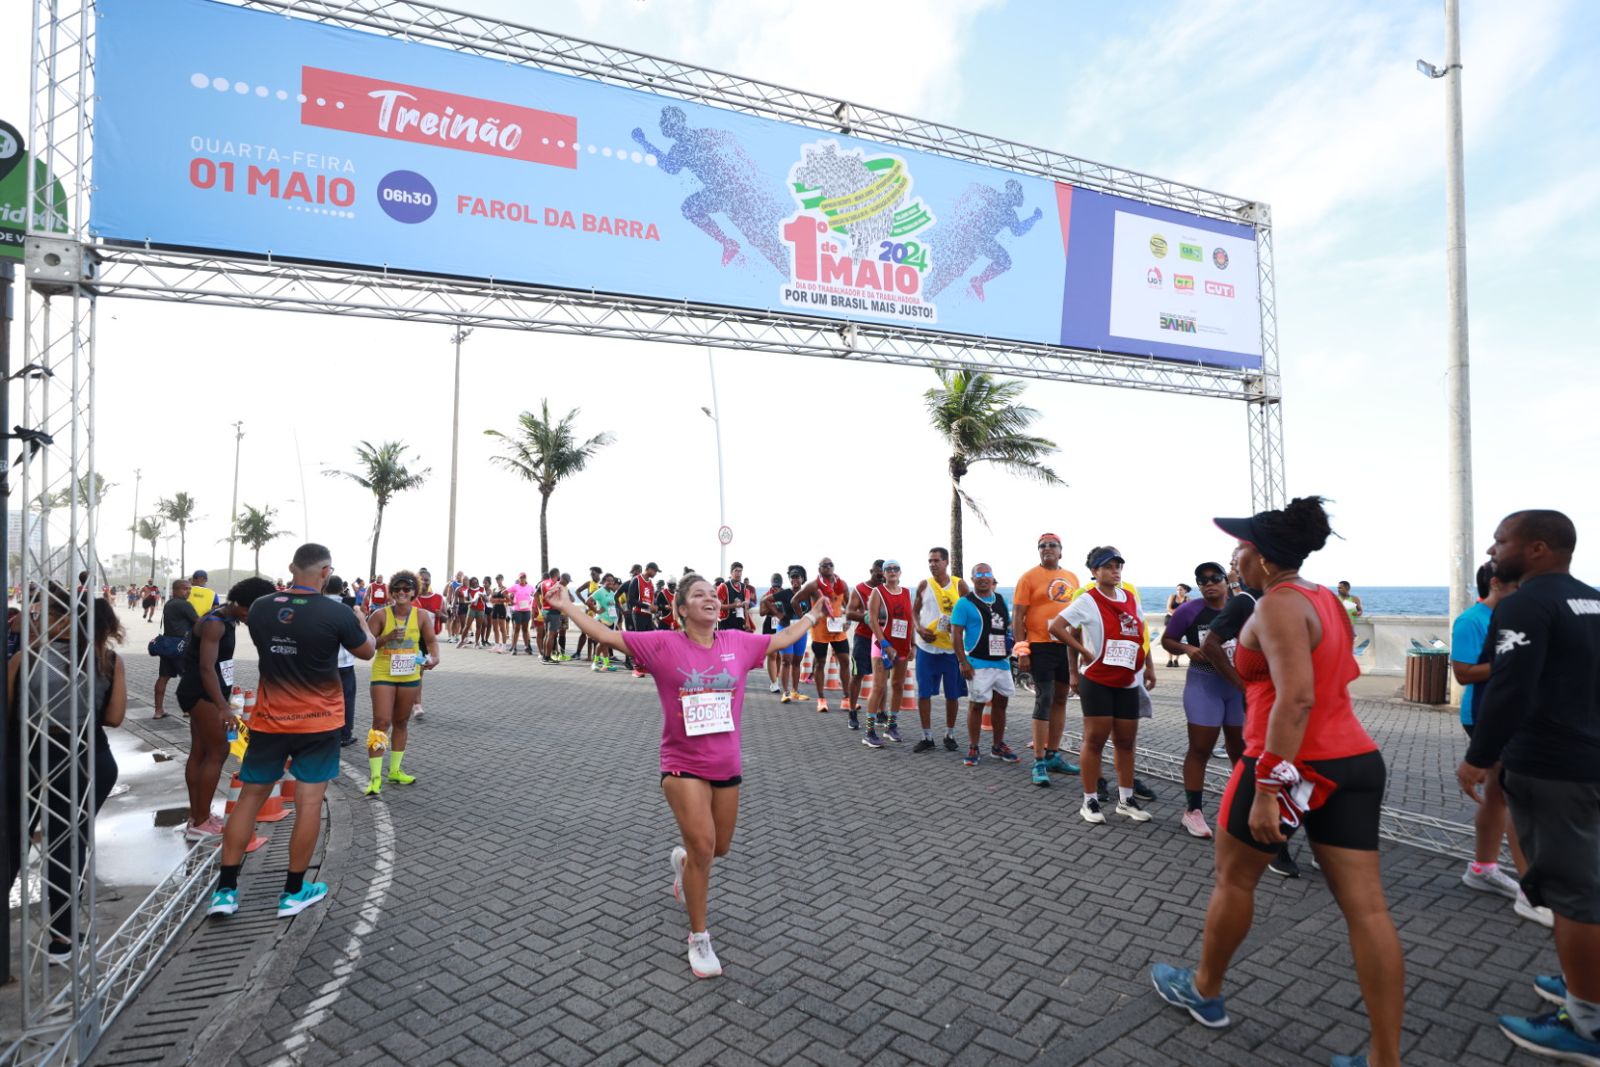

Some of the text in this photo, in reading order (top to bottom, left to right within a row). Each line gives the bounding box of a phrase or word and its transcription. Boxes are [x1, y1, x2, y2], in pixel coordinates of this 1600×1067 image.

[368, 90, 522, 151] Treinão
[191, 136, 355, 173] QUARTA-FEIRA
[189, 157, 355, 207] 01 MAIO
[383, 188, 432, 206] 06h30
[457, 195, 660, 241] FAROL DA BARRA
[821, 241, 838, 253] de
[879, 241, 928, 272] 2024
[796, 282, 806, 290] DIA
[818, 285, 861, 297] TRABALHADOR
[821, 254, 919, 295] MAIO
[785, 289, 933, 318] POR UM BRASIL MAIS JUSTO!
